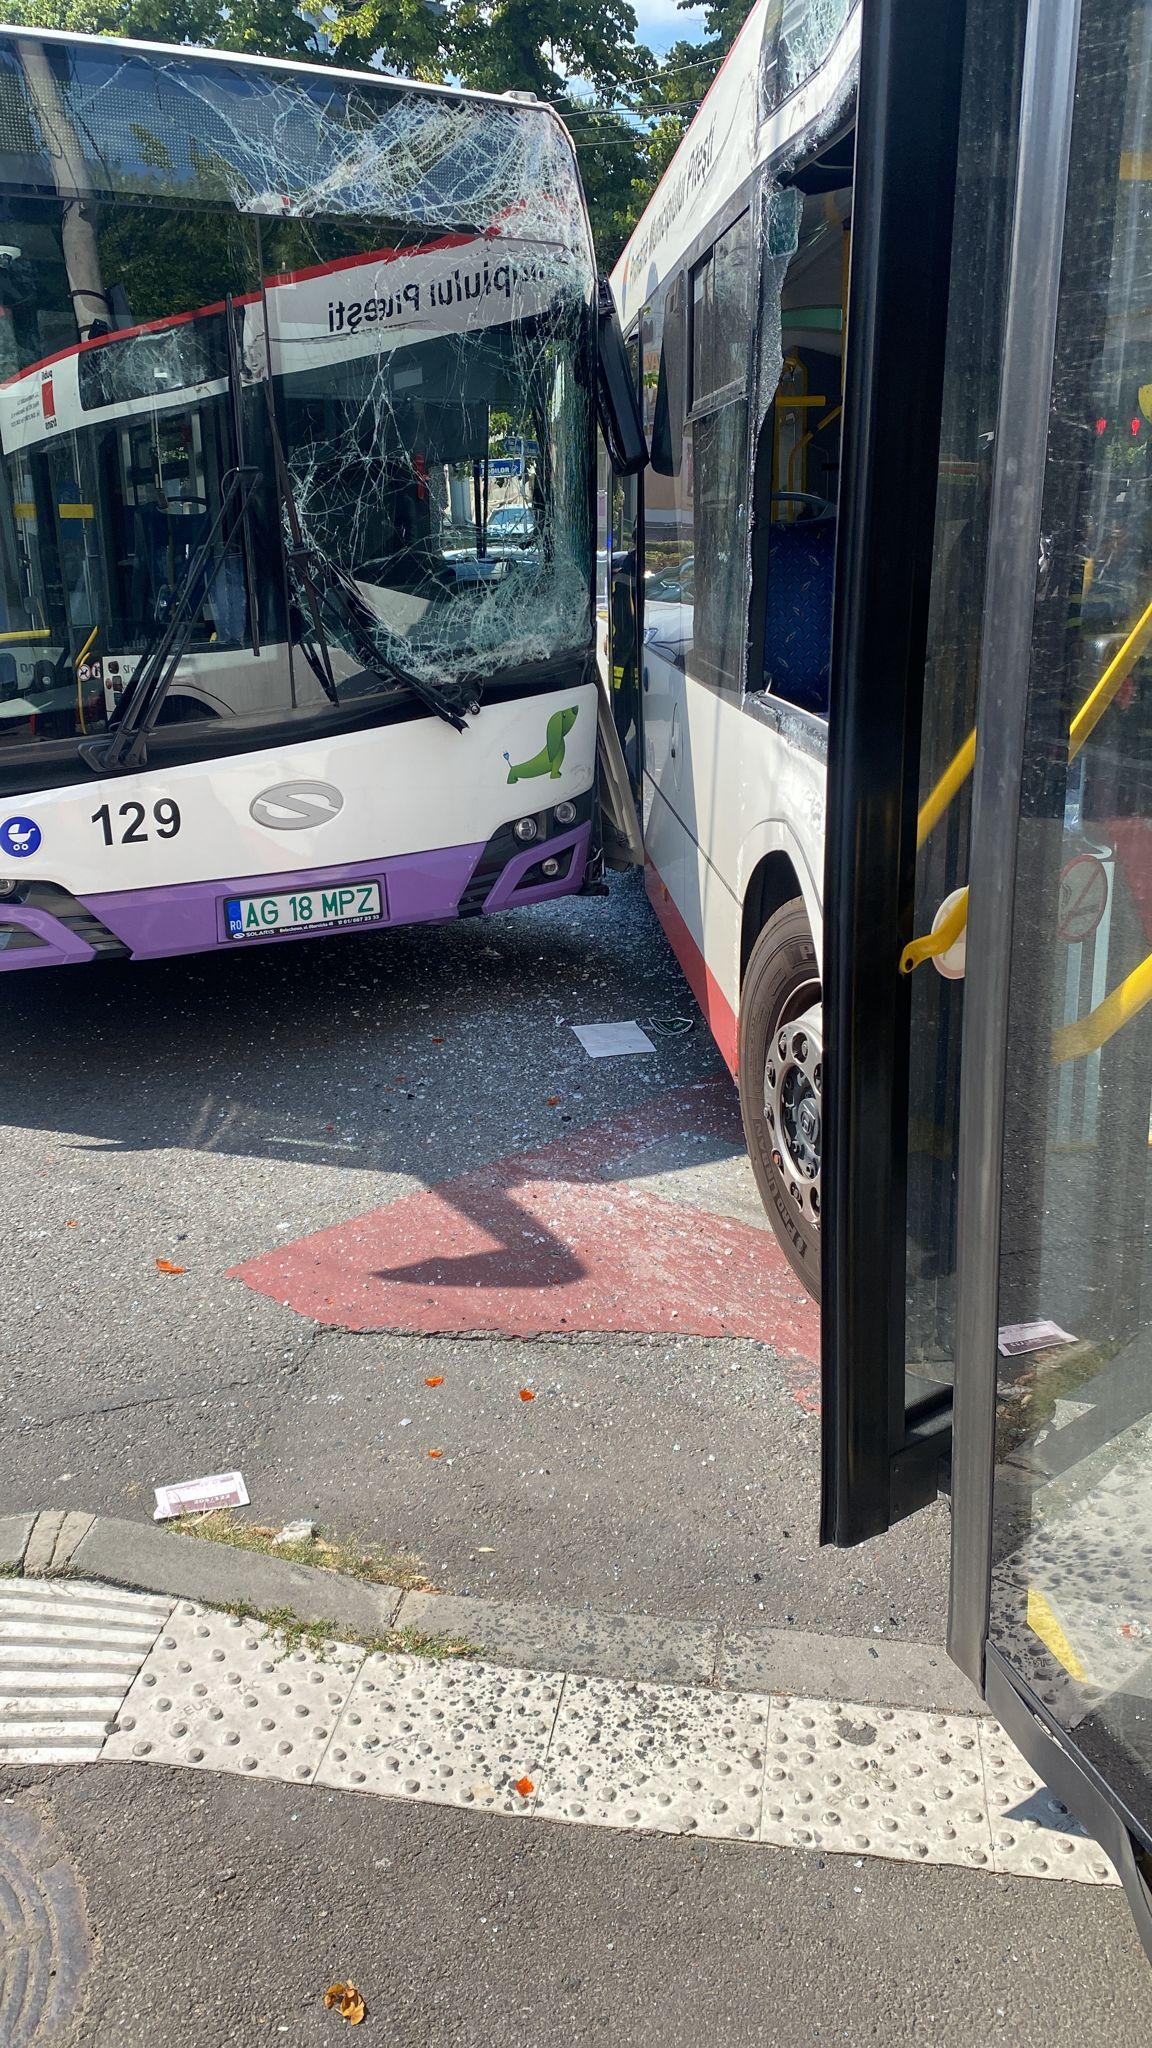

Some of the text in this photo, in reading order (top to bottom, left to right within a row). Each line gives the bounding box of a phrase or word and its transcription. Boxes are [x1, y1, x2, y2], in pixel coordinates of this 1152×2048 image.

[91, 798, 181, 846] 129
[246, 887, 374, 928] AG 18 MPZ
[230, 920, 242, 931] RO
[246, 929, 275, 937] SOLARIS
